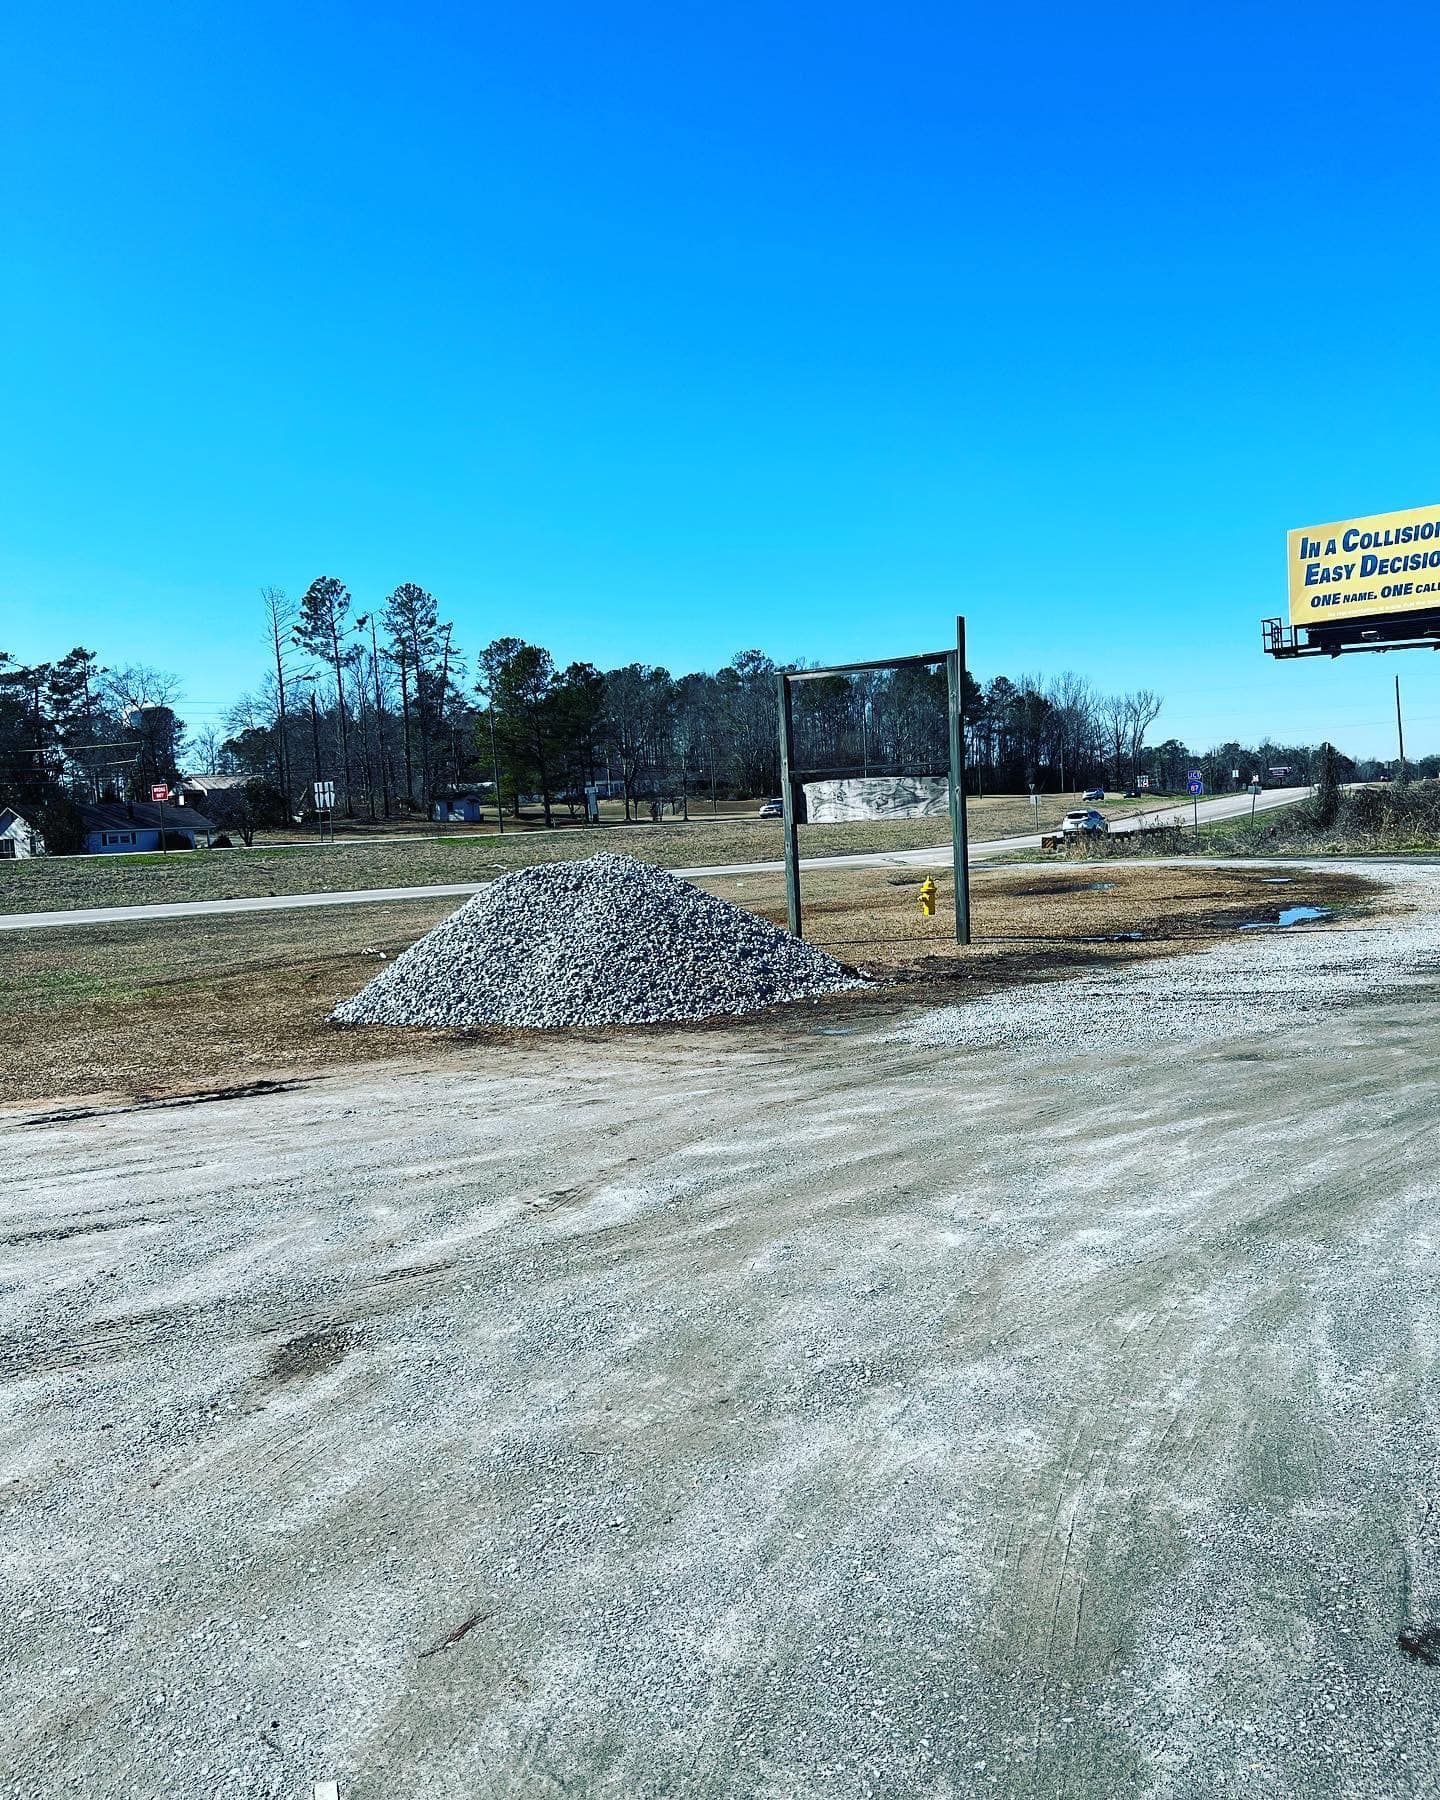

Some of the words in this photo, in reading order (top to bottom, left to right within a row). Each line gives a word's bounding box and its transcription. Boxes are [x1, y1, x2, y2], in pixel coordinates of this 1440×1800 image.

[1300, 537, 1320, 559] IN
[1325, 538, 1336, 556] A
[1304, 563, 1356, 586] EASY
[1310, 592, 1341, 608] ONE
[1380, 582, 1413, 599] ONE
